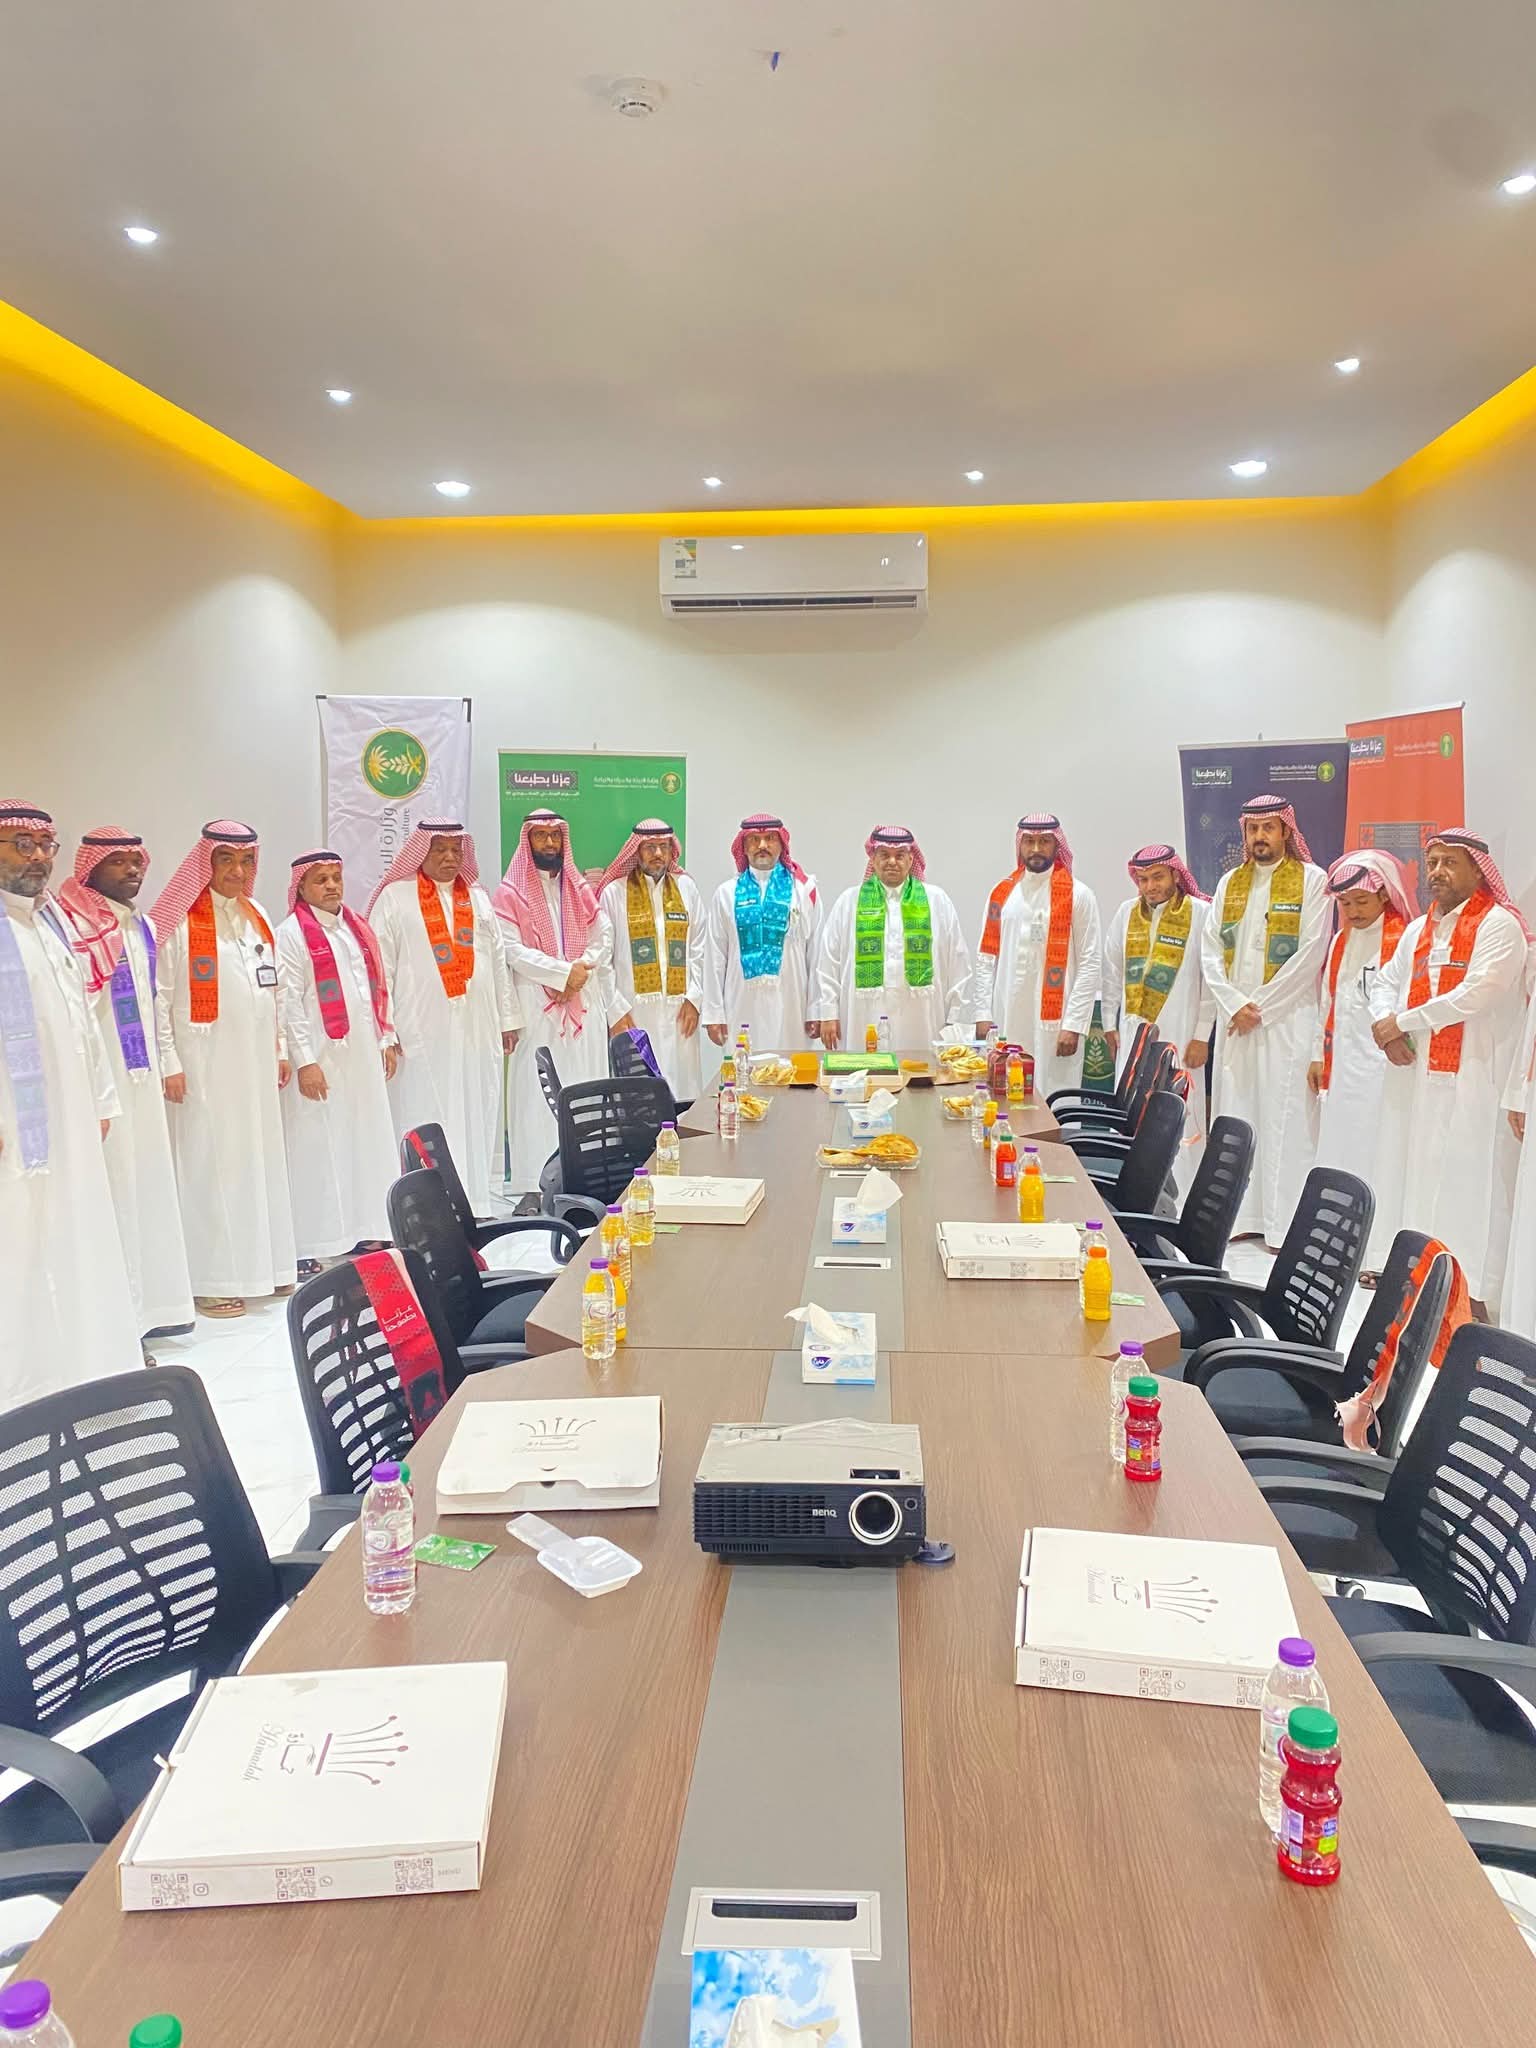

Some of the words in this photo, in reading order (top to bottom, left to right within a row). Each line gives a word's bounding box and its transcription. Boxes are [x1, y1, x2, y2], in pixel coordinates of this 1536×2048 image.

[514, 772, 550, 787] بطبعنا
[552, 772, 571, 787] عزنا
[380, 807, 398, 845] وزارة
